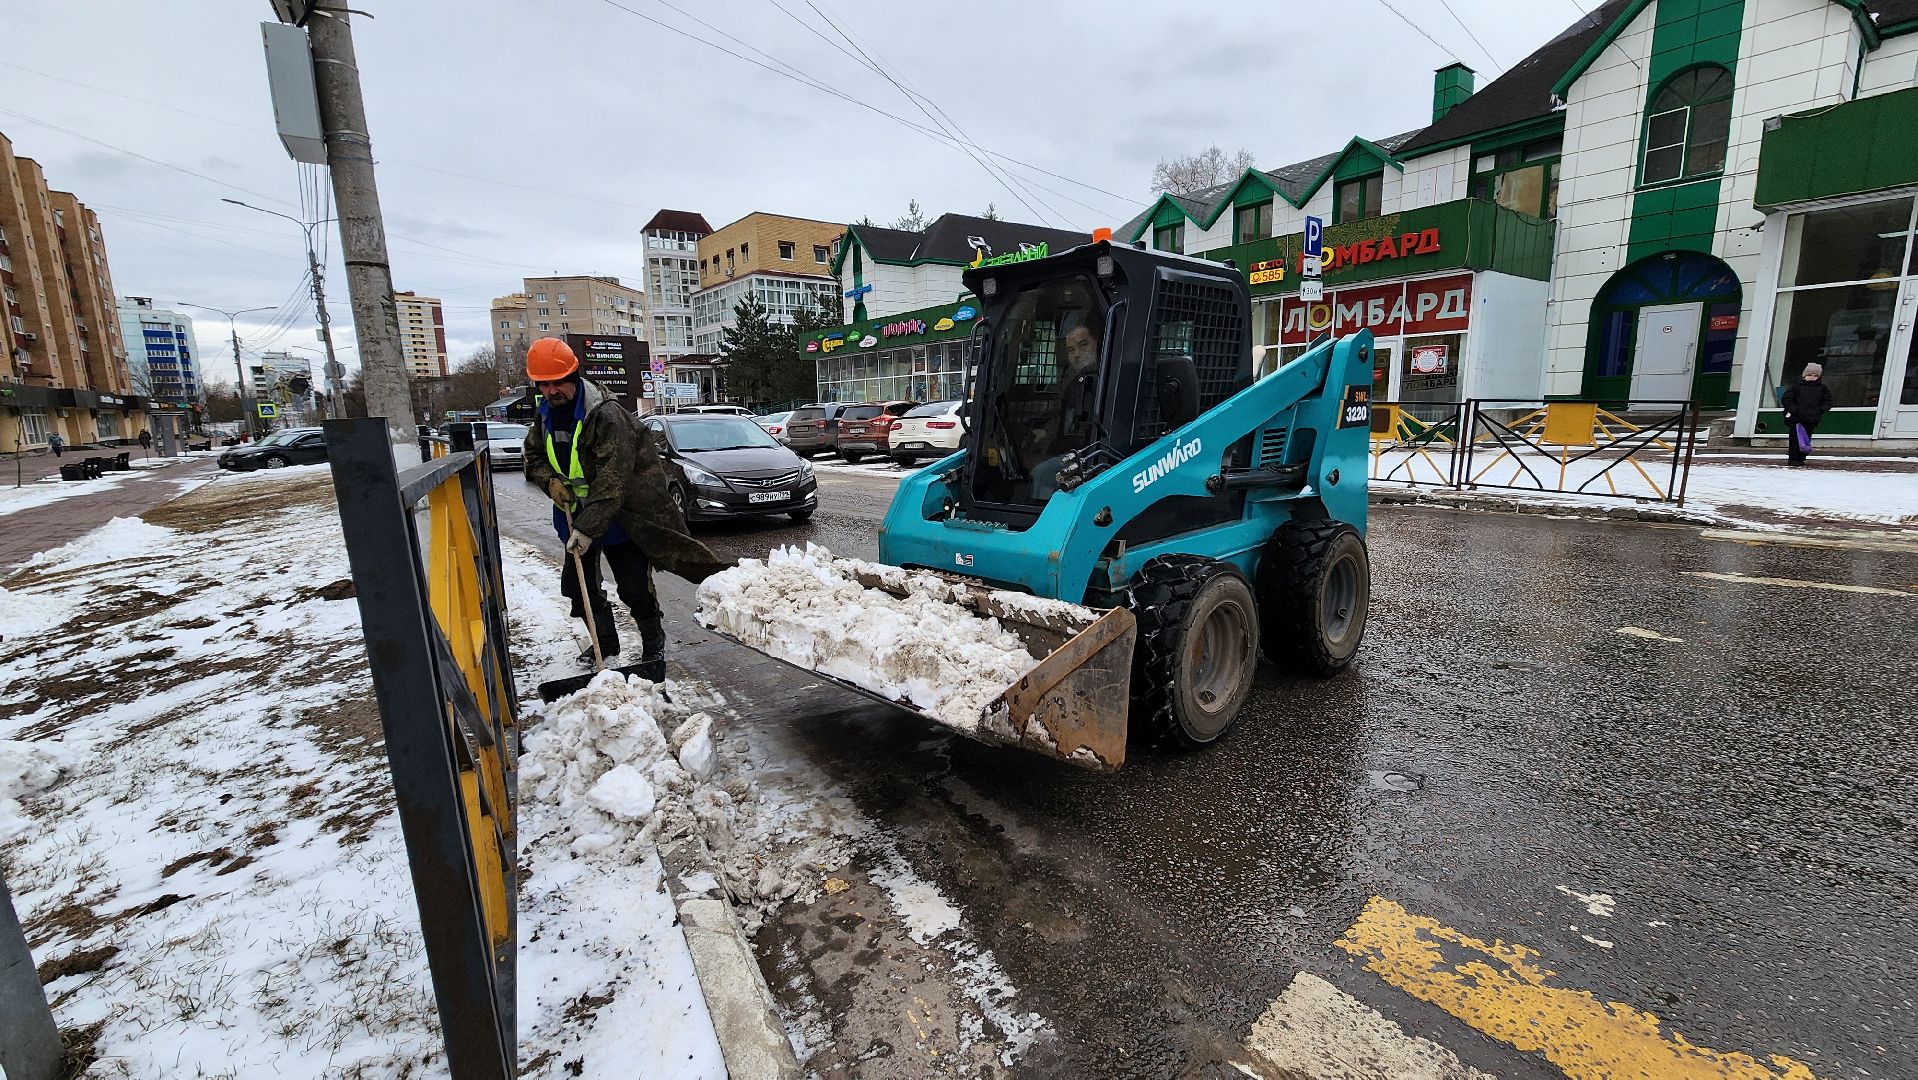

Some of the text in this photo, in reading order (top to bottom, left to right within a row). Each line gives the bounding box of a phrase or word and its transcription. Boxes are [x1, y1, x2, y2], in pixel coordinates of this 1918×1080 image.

[1309, 220, 1319, 251] P
[1262, 269, 1281, 282] 585
[1284, 288, 1468, 334] ЛОМБАРД
[1346, 405, 1367, 423] 3220
[1132, 437, 1202, 494] SUNWARD
